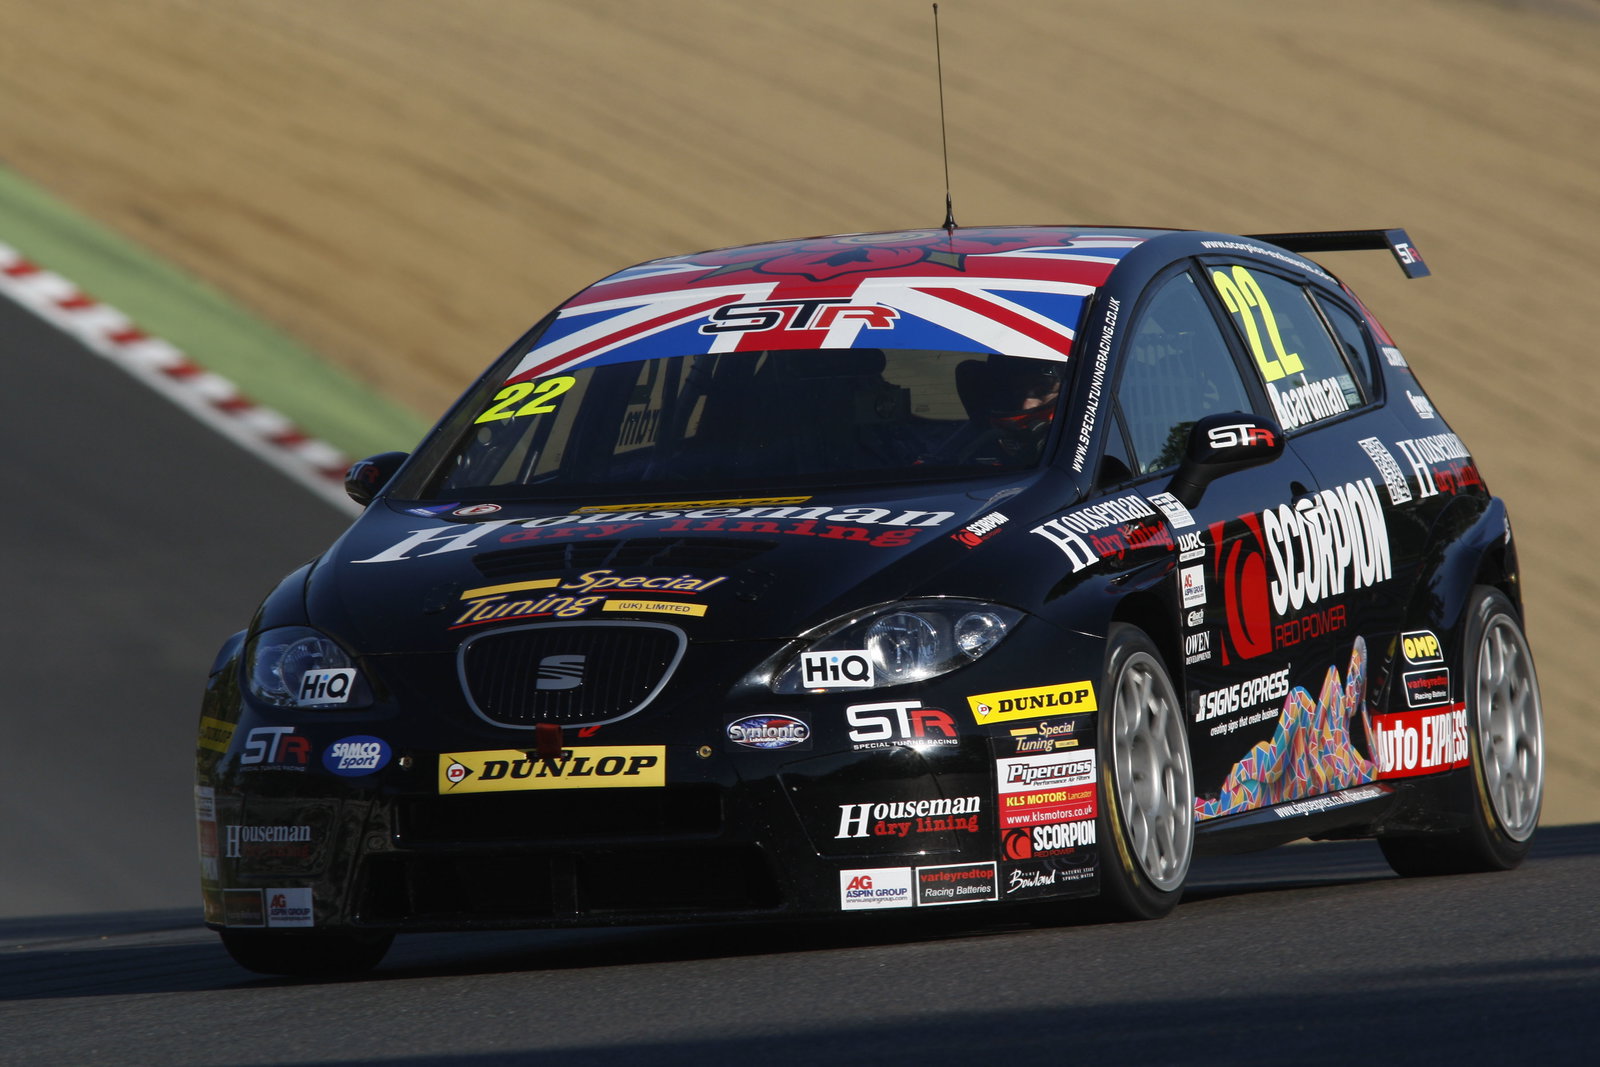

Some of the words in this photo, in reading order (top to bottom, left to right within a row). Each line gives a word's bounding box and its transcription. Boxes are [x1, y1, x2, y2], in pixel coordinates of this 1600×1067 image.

[1395, 243, 1422, 264] STR
[698, 297, 900, 335] STR
[1212, 265, 1304, 382] 22
[1072, 296, 1121, 474] WWW.SPECIALTUNINGRACING.CO.UK
[474, 376, 576, 425] 22
[1266, 372, 1349, 431] Boardman
[1208, 423, 1275, 449] STR
[350, 506, 955, 563] Houseman
[499, 522, 643, 543] dry
[659, 518, 924, 547] lining
[1029, 494, 1156, 574] Houseman
[1177, 530, 1205, 552] WRC
[1089, 534, 1125, 560] dry
[1263, 477, 1392, 616] SCORPION
[561, 570, 728, 592] Special
[1184, 573, 1192, 588] AG
[452, 594, 607, 624] Tuning
[618, 601, 643, 611] (UK)
[645, 602, 690, 613] LIMITED
[1275, 619, 1301, 649] RED
[1302, 604, 1347, 641] POWER
[1185, 631, 1210, 656] OWEN
[1404, 635, 1437, 659] OMP
[805, 655, 870, 682] HiQ
[301, 673, 349, 700] HiQ
[1205, 683, 1240, 719] SIGNS
[1241, 668, 1290, 709] EXPRESS
[1414, 691, 1432, 700] Racing
[998, 689, 1089, 713] DUNLOP
[846, 701, 957, 742] STR
[1039, 720, 1076, 737] Special
[1228, 720, 1239, 733] signs
[1239, 716, 1248, 728] that
[1261, 708, 1279, 721] business
[240, 726, 311, 765] STR
[729, 724, 804, 743] Synionic
[853, 741, 890, 750] SPECIAL
[892, 739, 925, 747] TUNING
[1015, 736, 1054, 751] Tuning
[1377, 720, 1419, 773] Auto
[1421, 709, 1468, 768] EXPRESS
[331, 742, 381, 758] SAMCO
[342, 755, 376, 768] sport
[478, 755, 658, 781] DUNLOP
[1007, 760, 1092, 785] Pipercross
[1033, 778, 1067, 787] Performance
[1007, 796, 1026, 807] KLS
[1028, 792, 1066, 805] MOTORS
[1068, 791, 1092, 800] Lancaster
[834, 796, 981, 839] Houseman
[874, 821, 912, 837] dry
[916, 815, 979, 833] lining
[1007, 805, 1092, 824] www.klsmotors.co.uk
[225, 825, 311, 858] Houseman
[1033, 820, 1096, 851] SCORPION
[1034, 850, 1049, 858] RED
[1050, 847, 1076, 856] POWER
[846, 875, 872, 890] AG
[920, 869, 994, 883] varleyredtop
[1007, 869, 1056, 893] Bowland
[271, 895, 286, 908] AG
[846, 890, 873, 898] ASPIN
[876, 888, 908, 897] GROUP
[925, 888, 954, 898] Racing
[956, 885, 991, 895] Batteries
